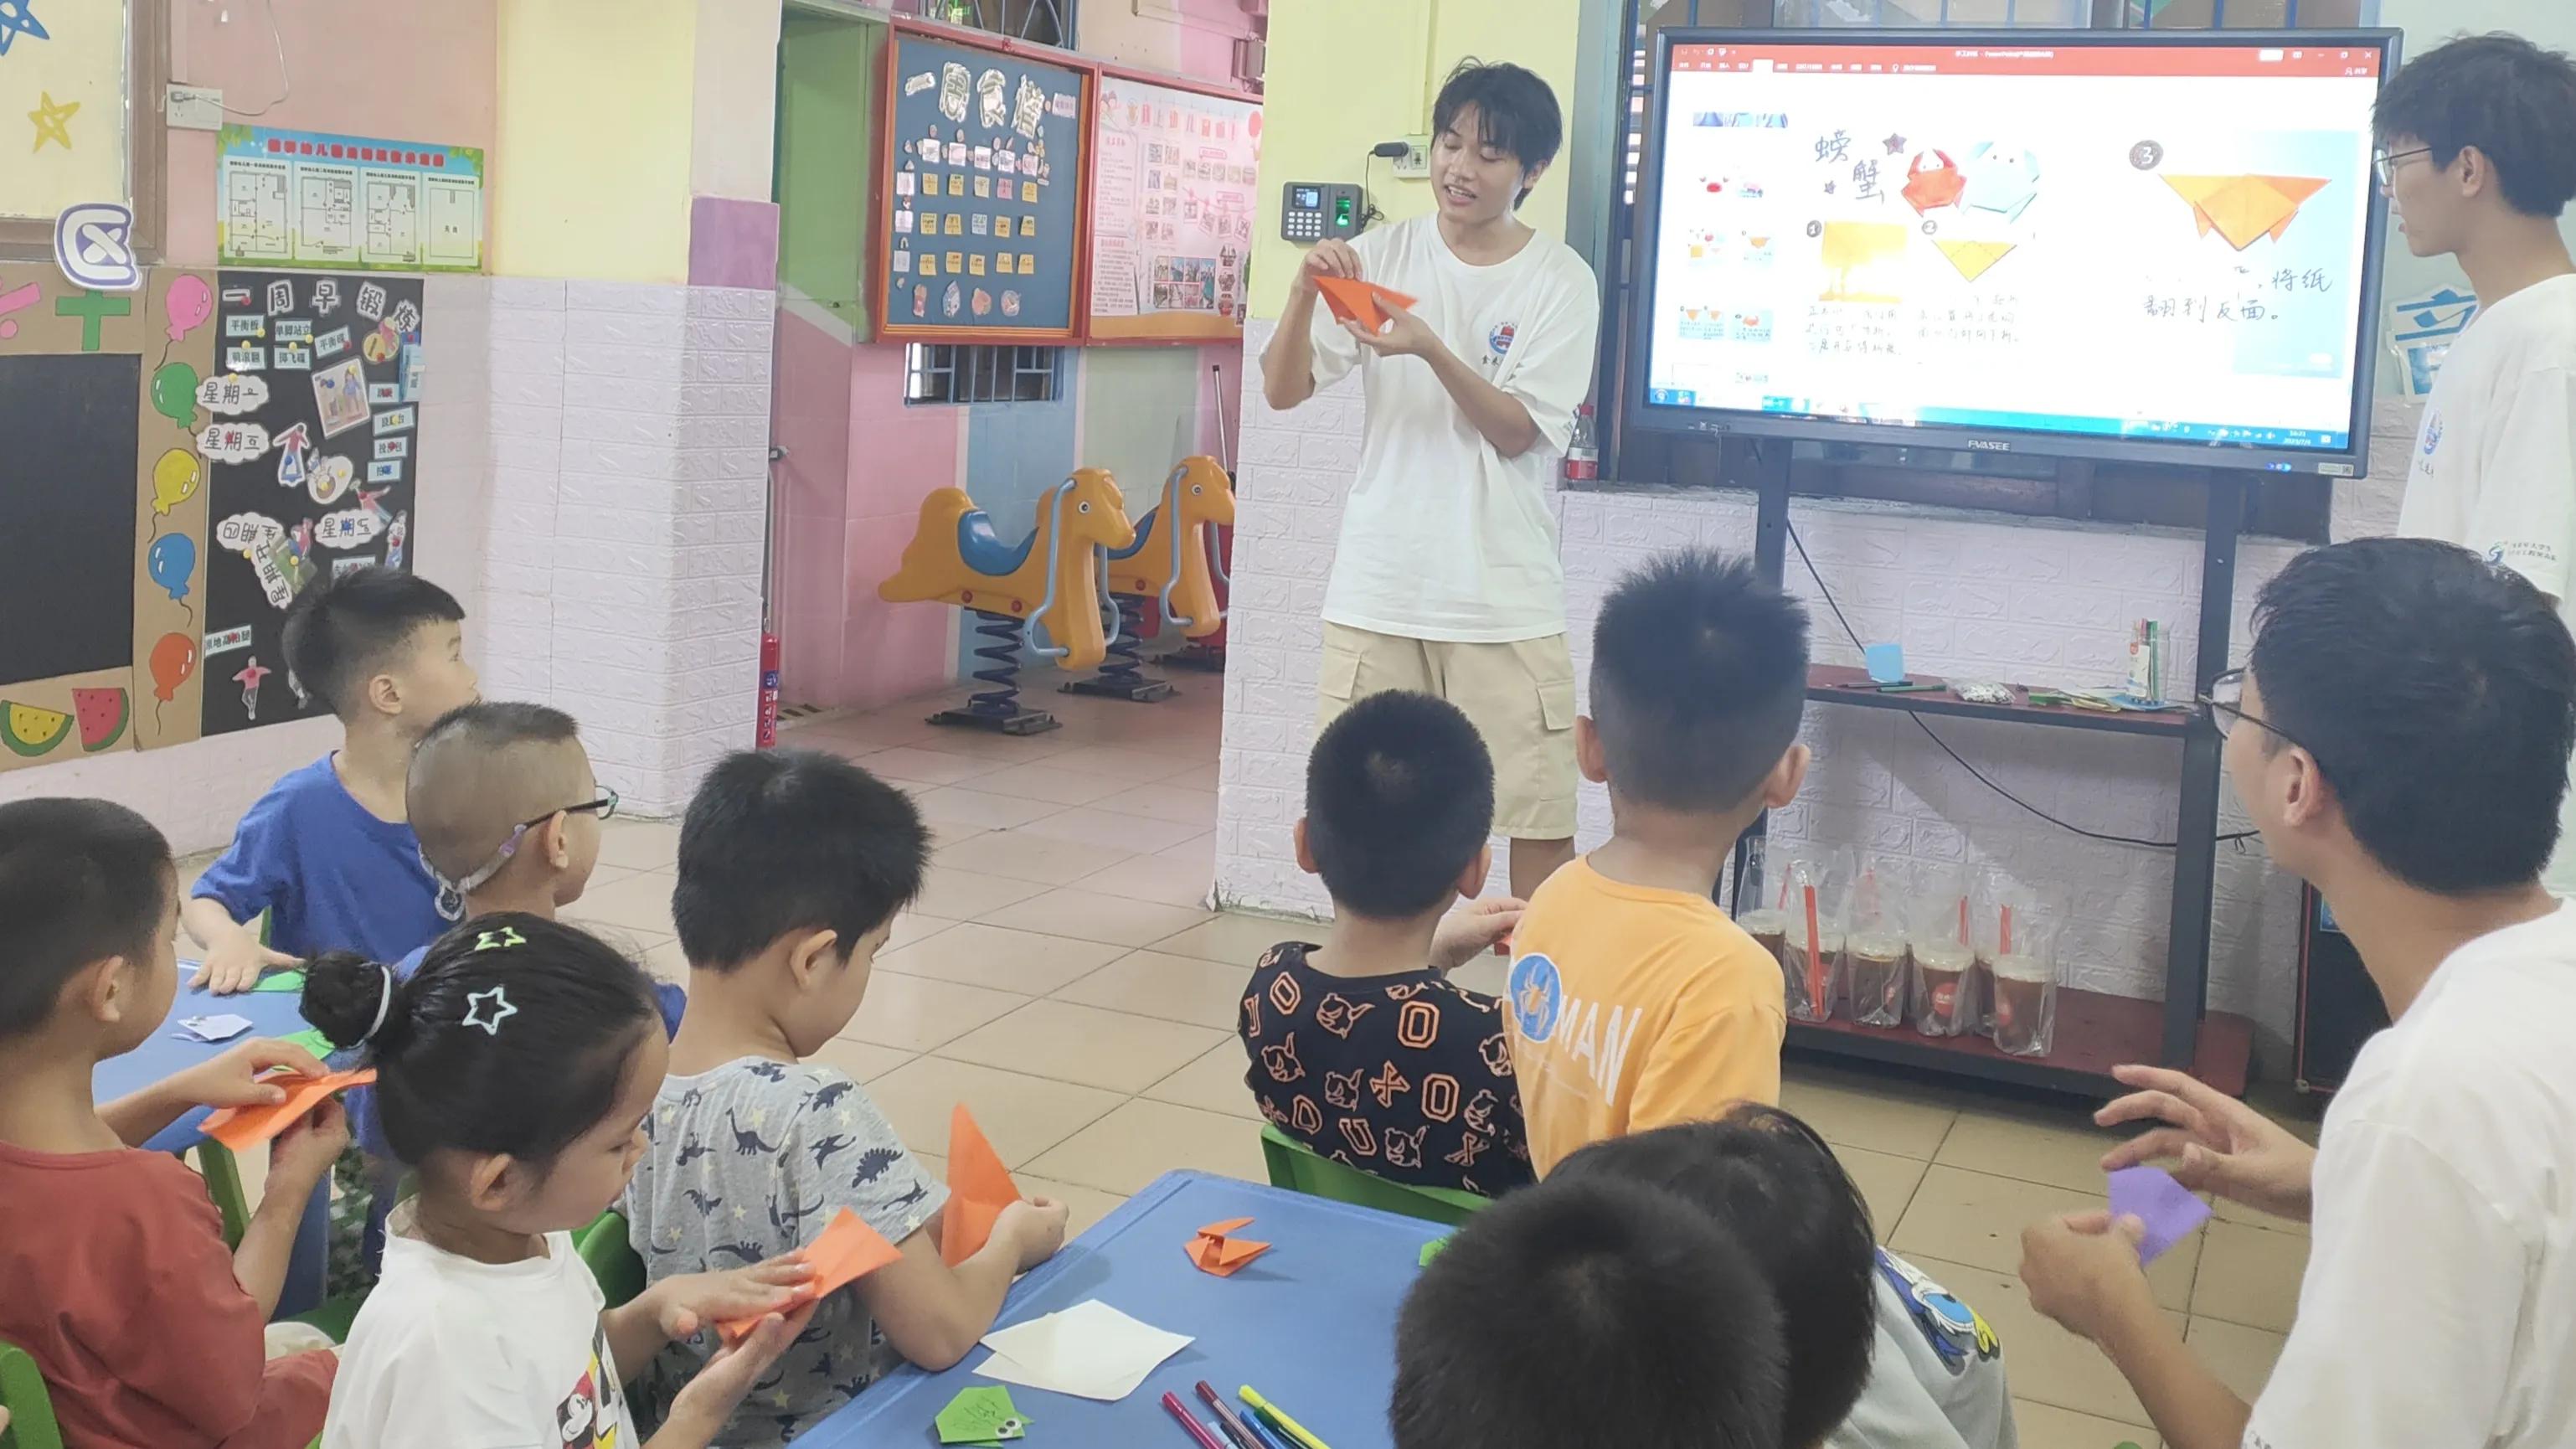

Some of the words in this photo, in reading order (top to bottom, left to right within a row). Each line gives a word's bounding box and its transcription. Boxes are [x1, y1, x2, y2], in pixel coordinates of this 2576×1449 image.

[1397, 1000, 1440, 1049] O
[1559, 994, 1643, 1106] MAN
[1421, 1073, 1461, 1122] O
